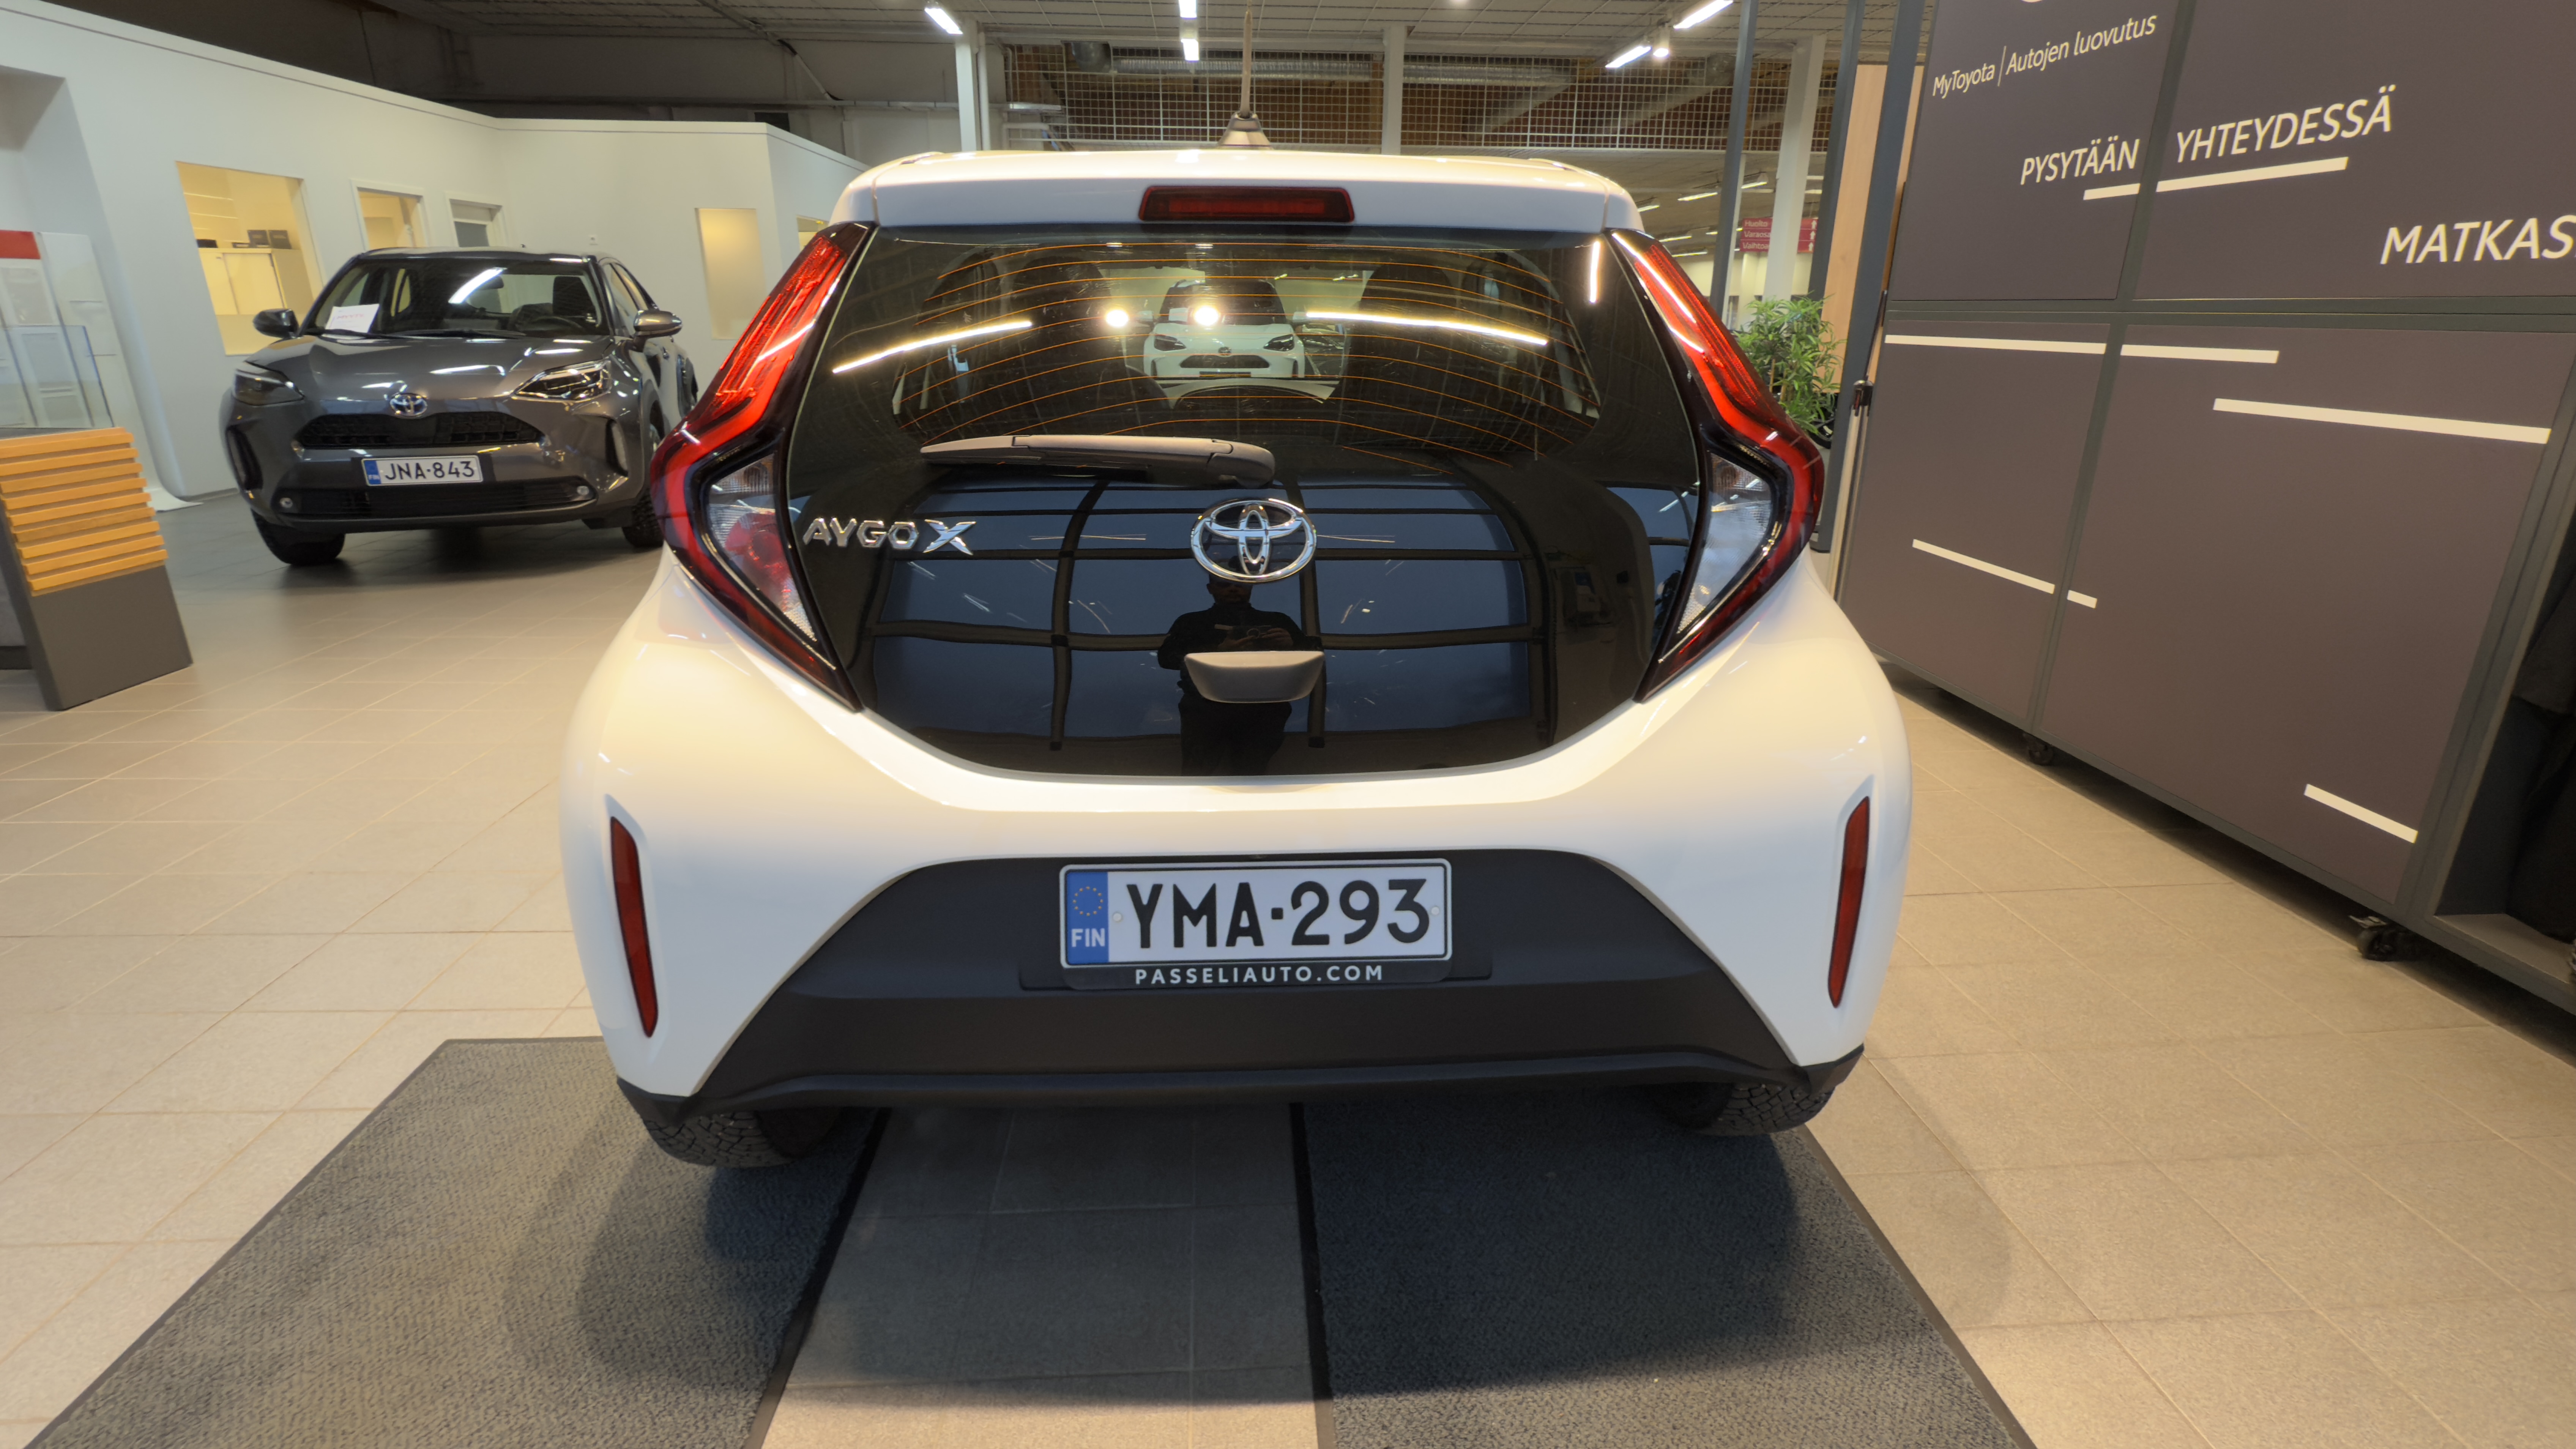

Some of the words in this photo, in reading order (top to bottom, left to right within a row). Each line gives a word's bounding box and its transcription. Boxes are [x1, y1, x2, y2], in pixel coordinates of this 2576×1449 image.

[2073, 14, 2158, 55] luovutus
[2020, 135, 2140, 185] PYSYTÄÄN
[2176, 84, 2396, 162] YHTEYDESSÄ
[2380, 214, 2576, 265] MATKAS
[385, 460, 474, 480] JNA-843
[1071, 928, 1105, 948] FIN
[1126, 878, 1430, 949] YMA-293
[1135, 965, 1383, 985] PASSELIAUTO.COM
